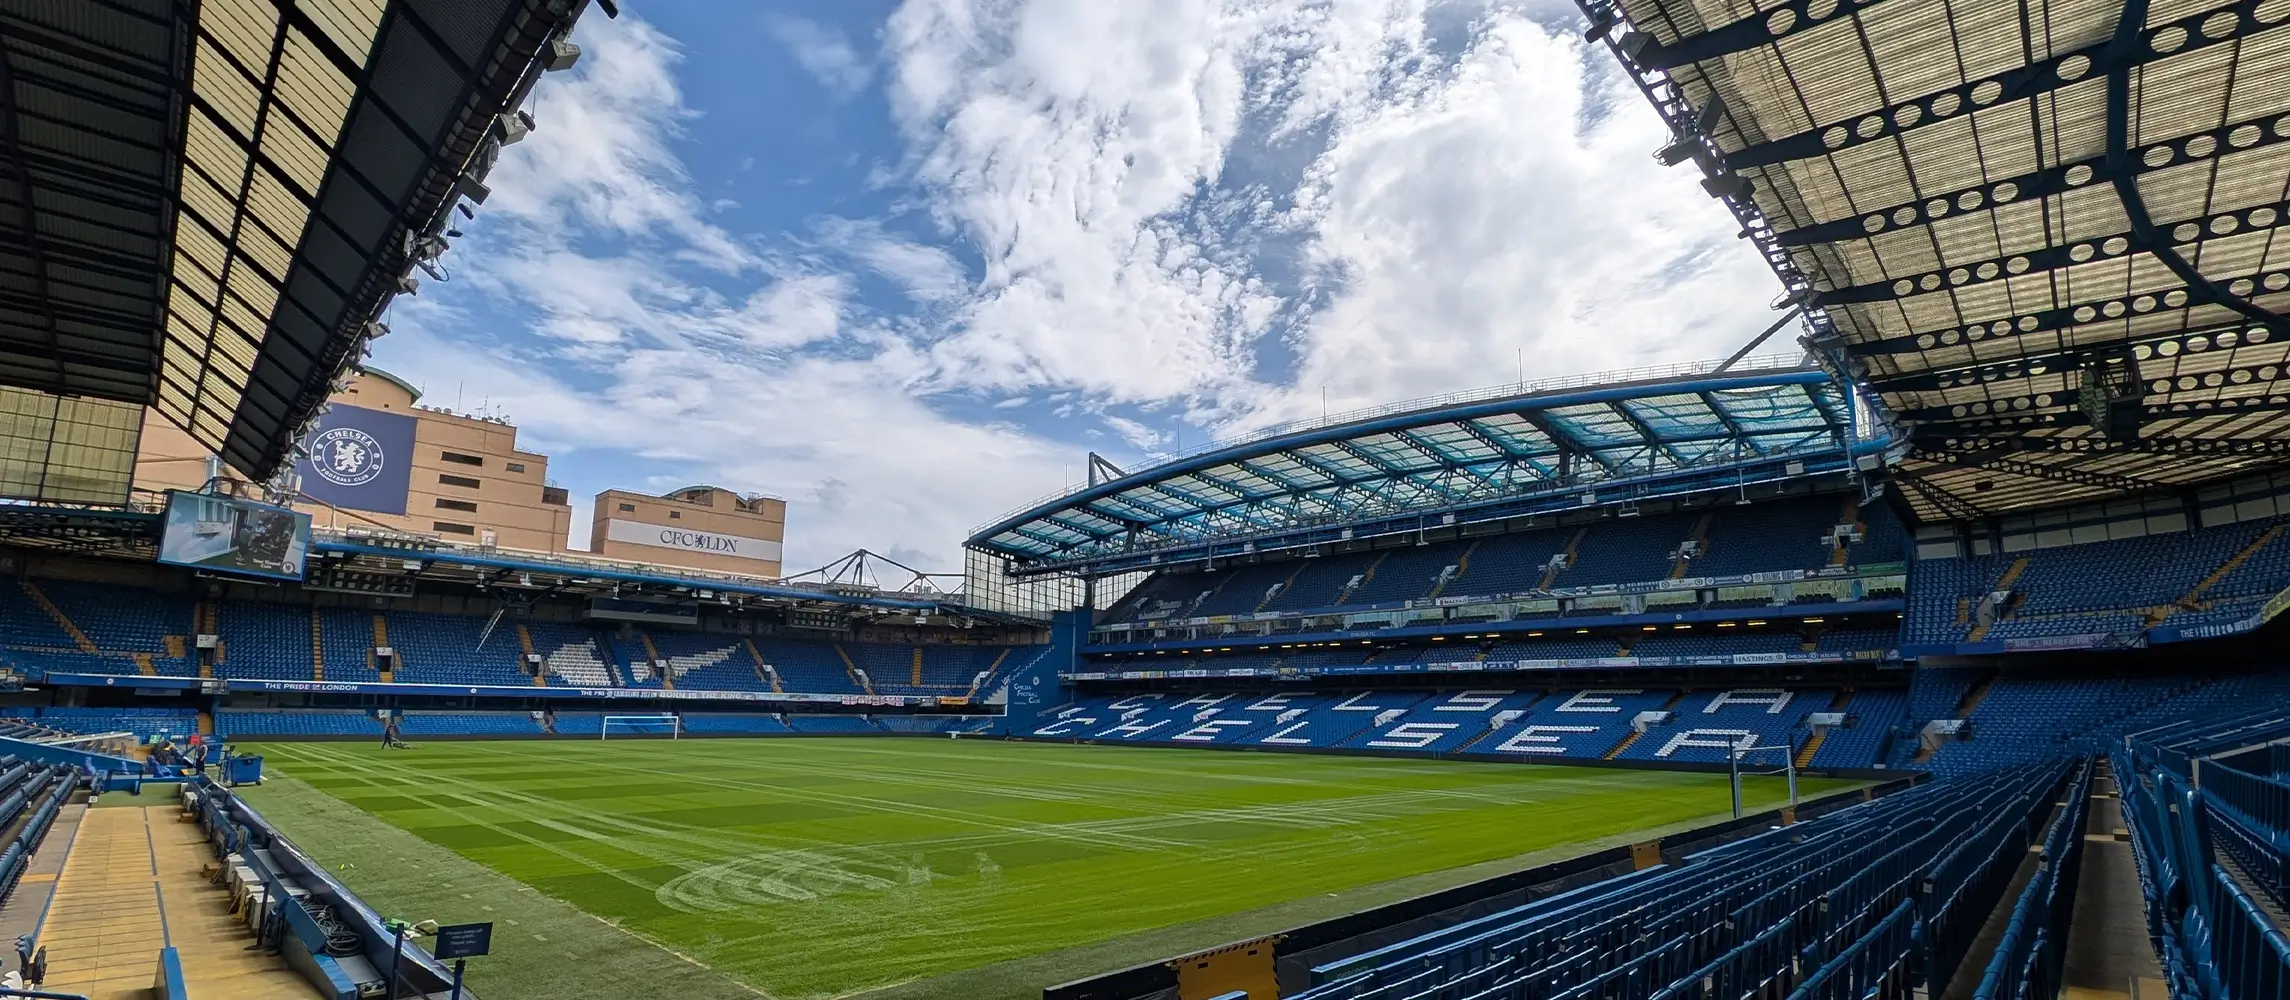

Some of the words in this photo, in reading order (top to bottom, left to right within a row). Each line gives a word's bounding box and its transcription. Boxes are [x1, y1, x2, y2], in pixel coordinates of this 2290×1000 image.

[326, 430, 373, 447] CHELSEA
[321, 468, 352, 483] FOOTBALL
[353, 474, 370, 483] CLUB
[660, 530, 694, 547] CFC
[706, 535, 739, 553] LDN
[1033, 717, 1760, 760] CHELSEA
